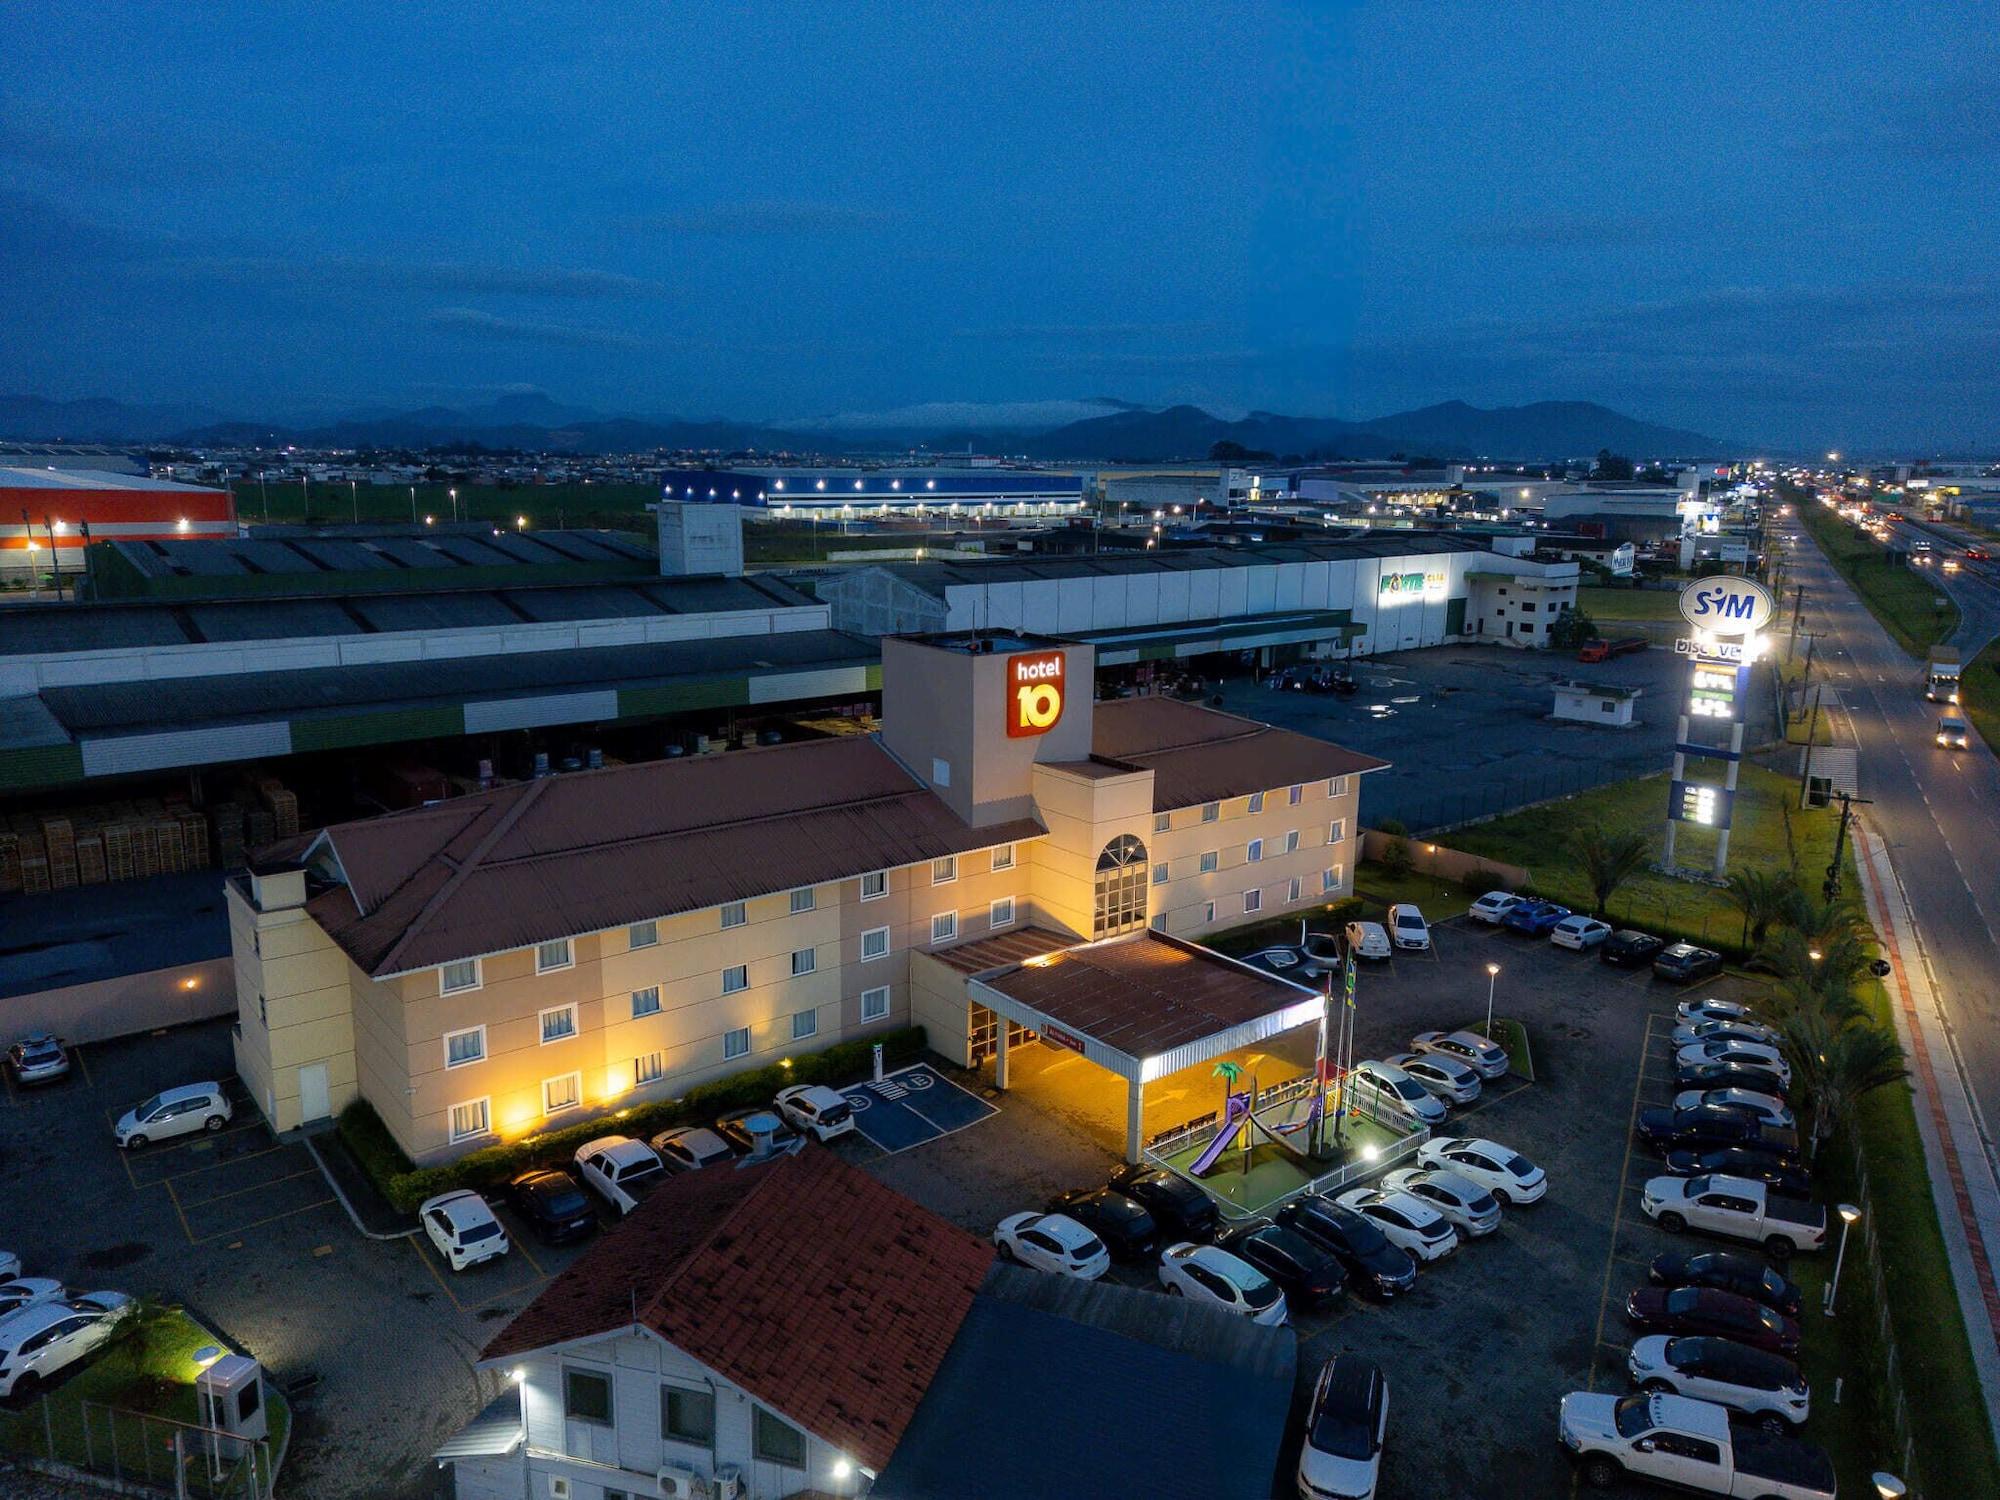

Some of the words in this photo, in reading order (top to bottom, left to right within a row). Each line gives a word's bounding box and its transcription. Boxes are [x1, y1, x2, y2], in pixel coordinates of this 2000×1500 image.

[1694, 587, 1755, 619] SIM
[1017, 656, 1061, 681] hotel
[1017, 683, 1061, 728] 10
